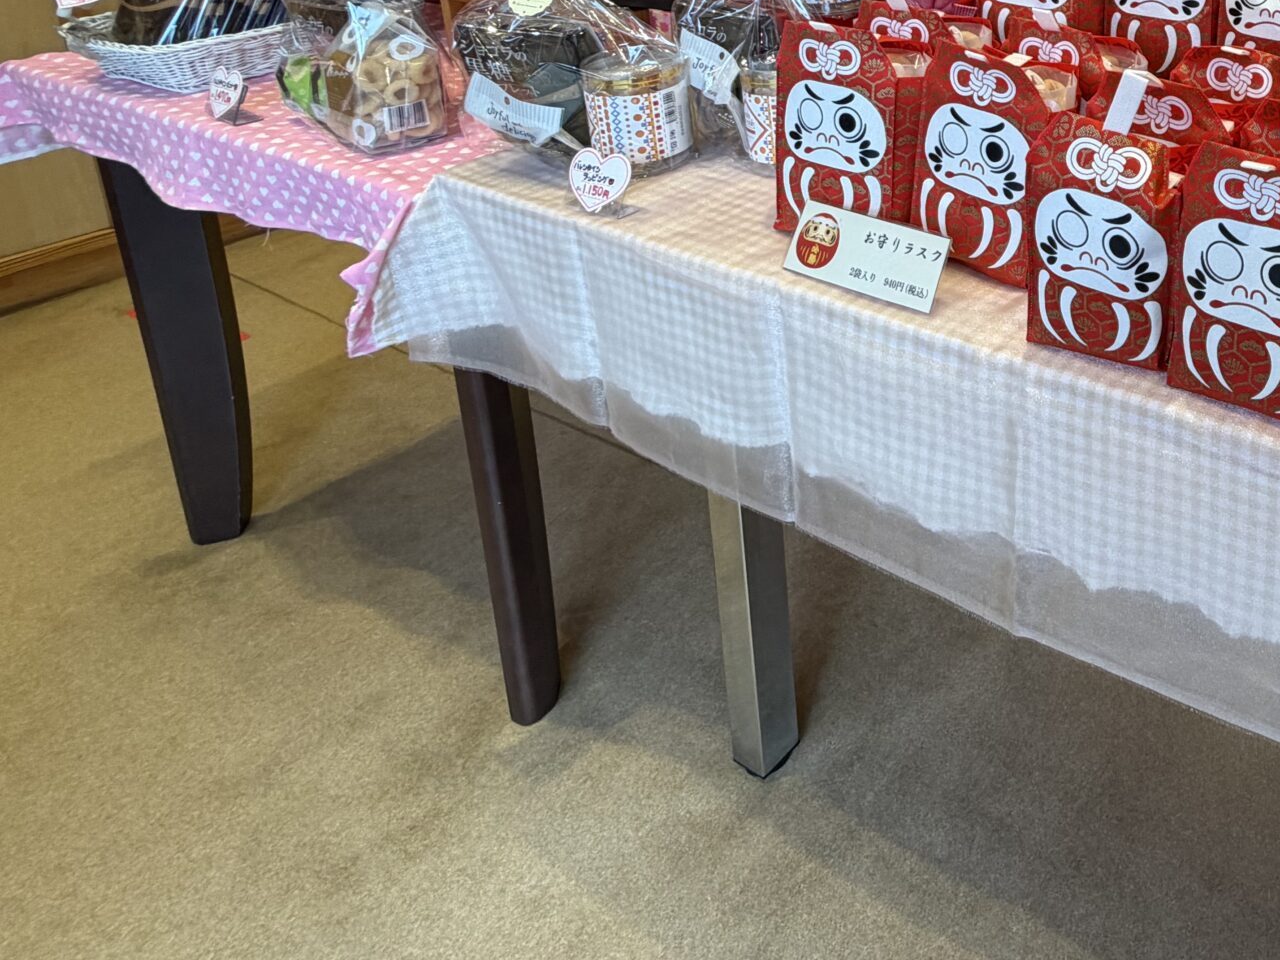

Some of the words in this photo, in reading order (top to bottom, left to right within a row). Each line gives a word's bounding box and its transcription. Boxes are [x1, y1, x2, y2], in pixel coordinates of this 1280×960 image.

[864, 230, 943, 263] お守りラスク
